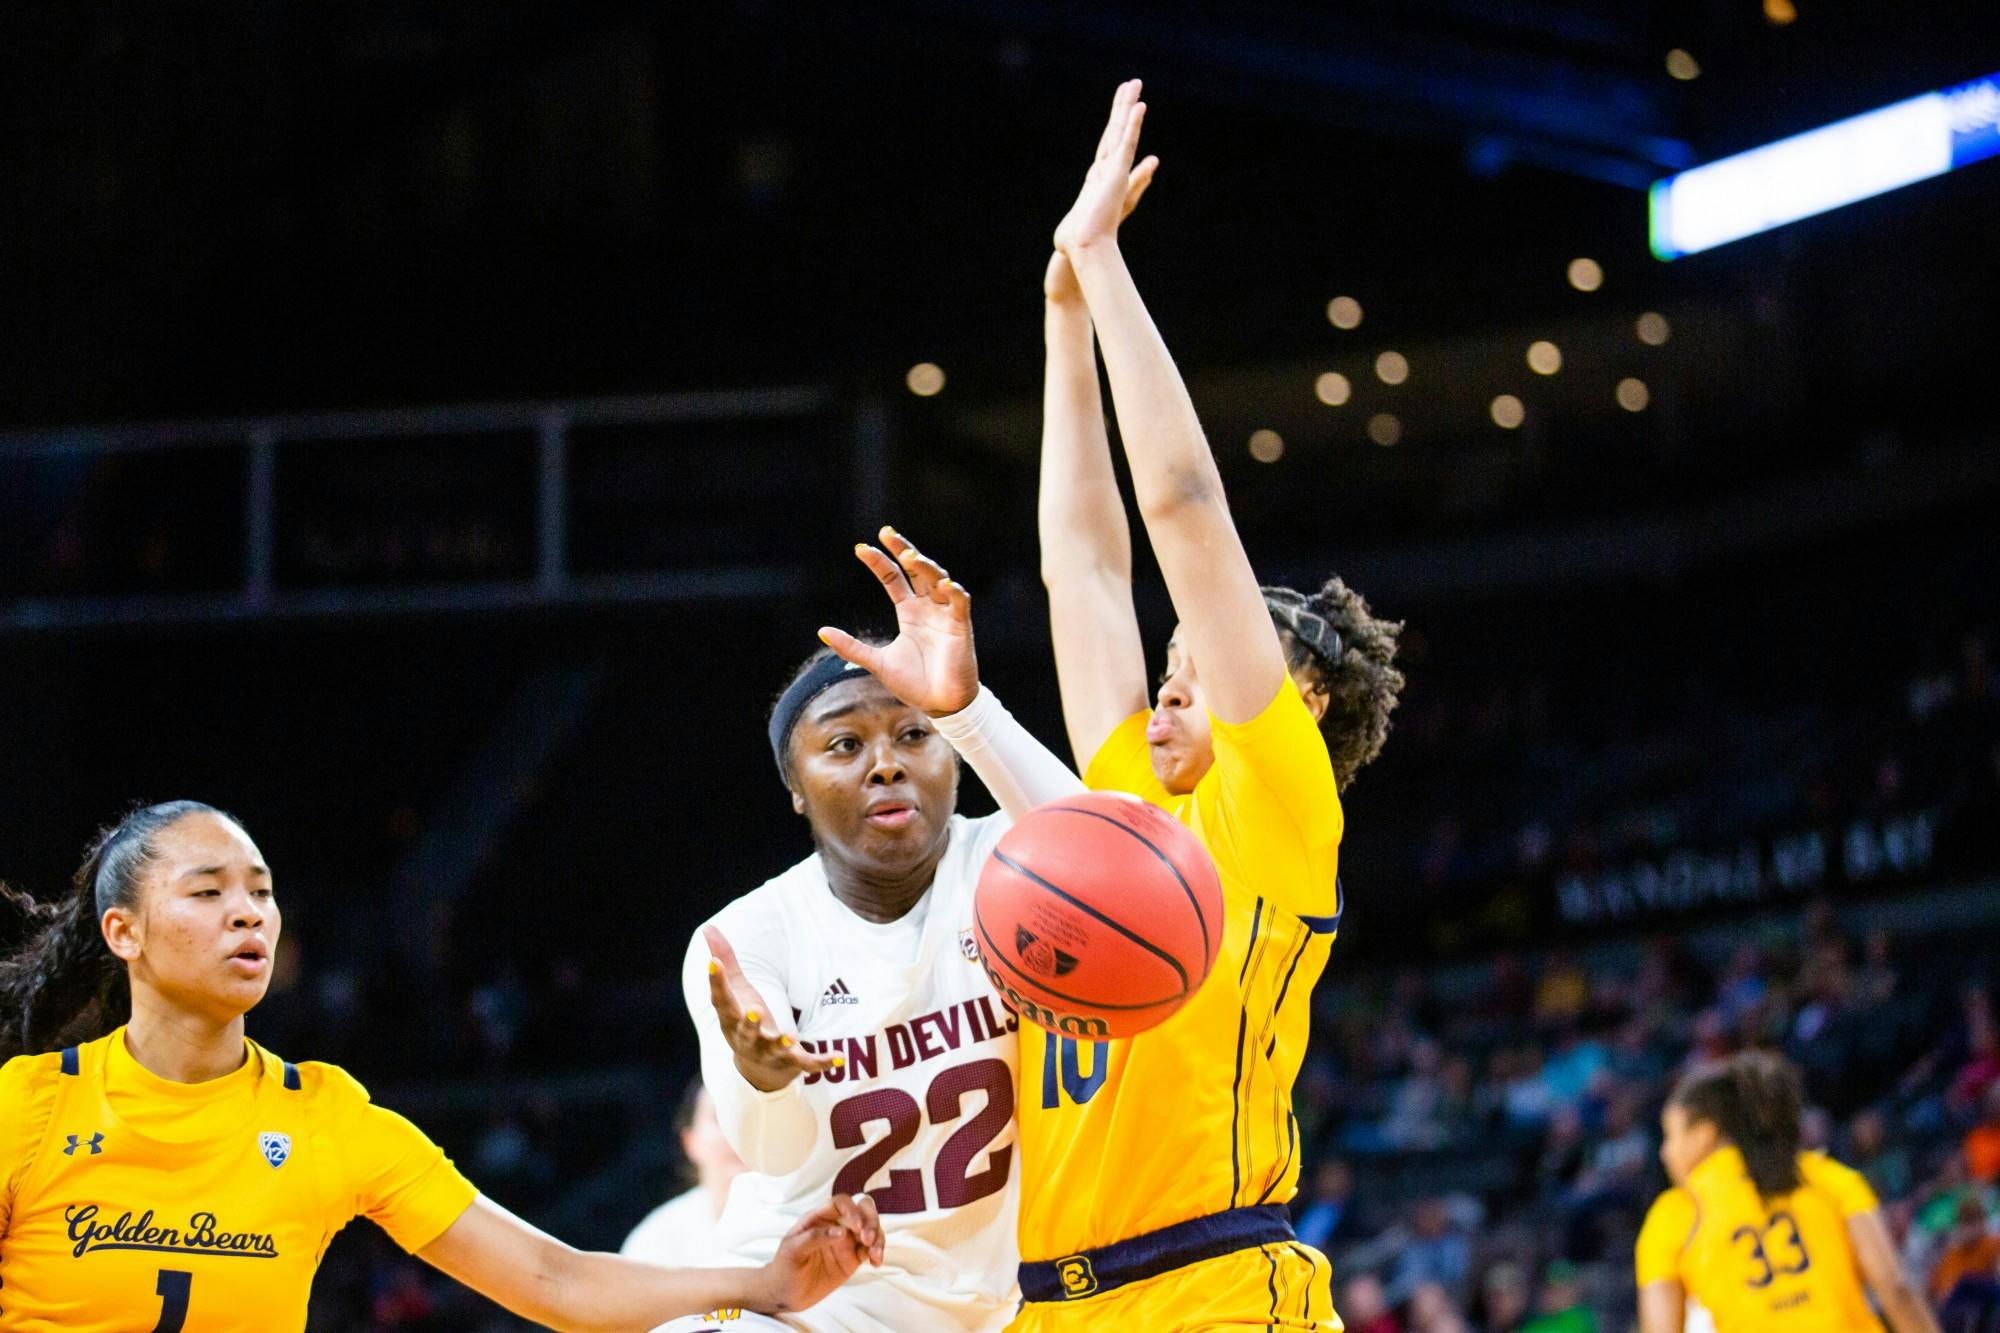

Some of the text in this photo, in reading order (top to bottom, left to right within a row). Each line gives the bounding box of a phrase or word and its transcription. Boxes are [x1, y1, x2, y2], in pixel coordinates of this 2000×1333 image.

[821, 994, 859, 1006] adidas
[885, 995, 1019, 1070] DEVILS
[1042, 1031, 1109, 1109] 10
[269, 1146, 284, 1161] 12
[830, 1058, 1015, 1214] 22
[65, 1205, 276, 1258] Golden Bears
[1732, 1210, 1809, 1288] 33
[151, 1269, 192, 1333] 1
